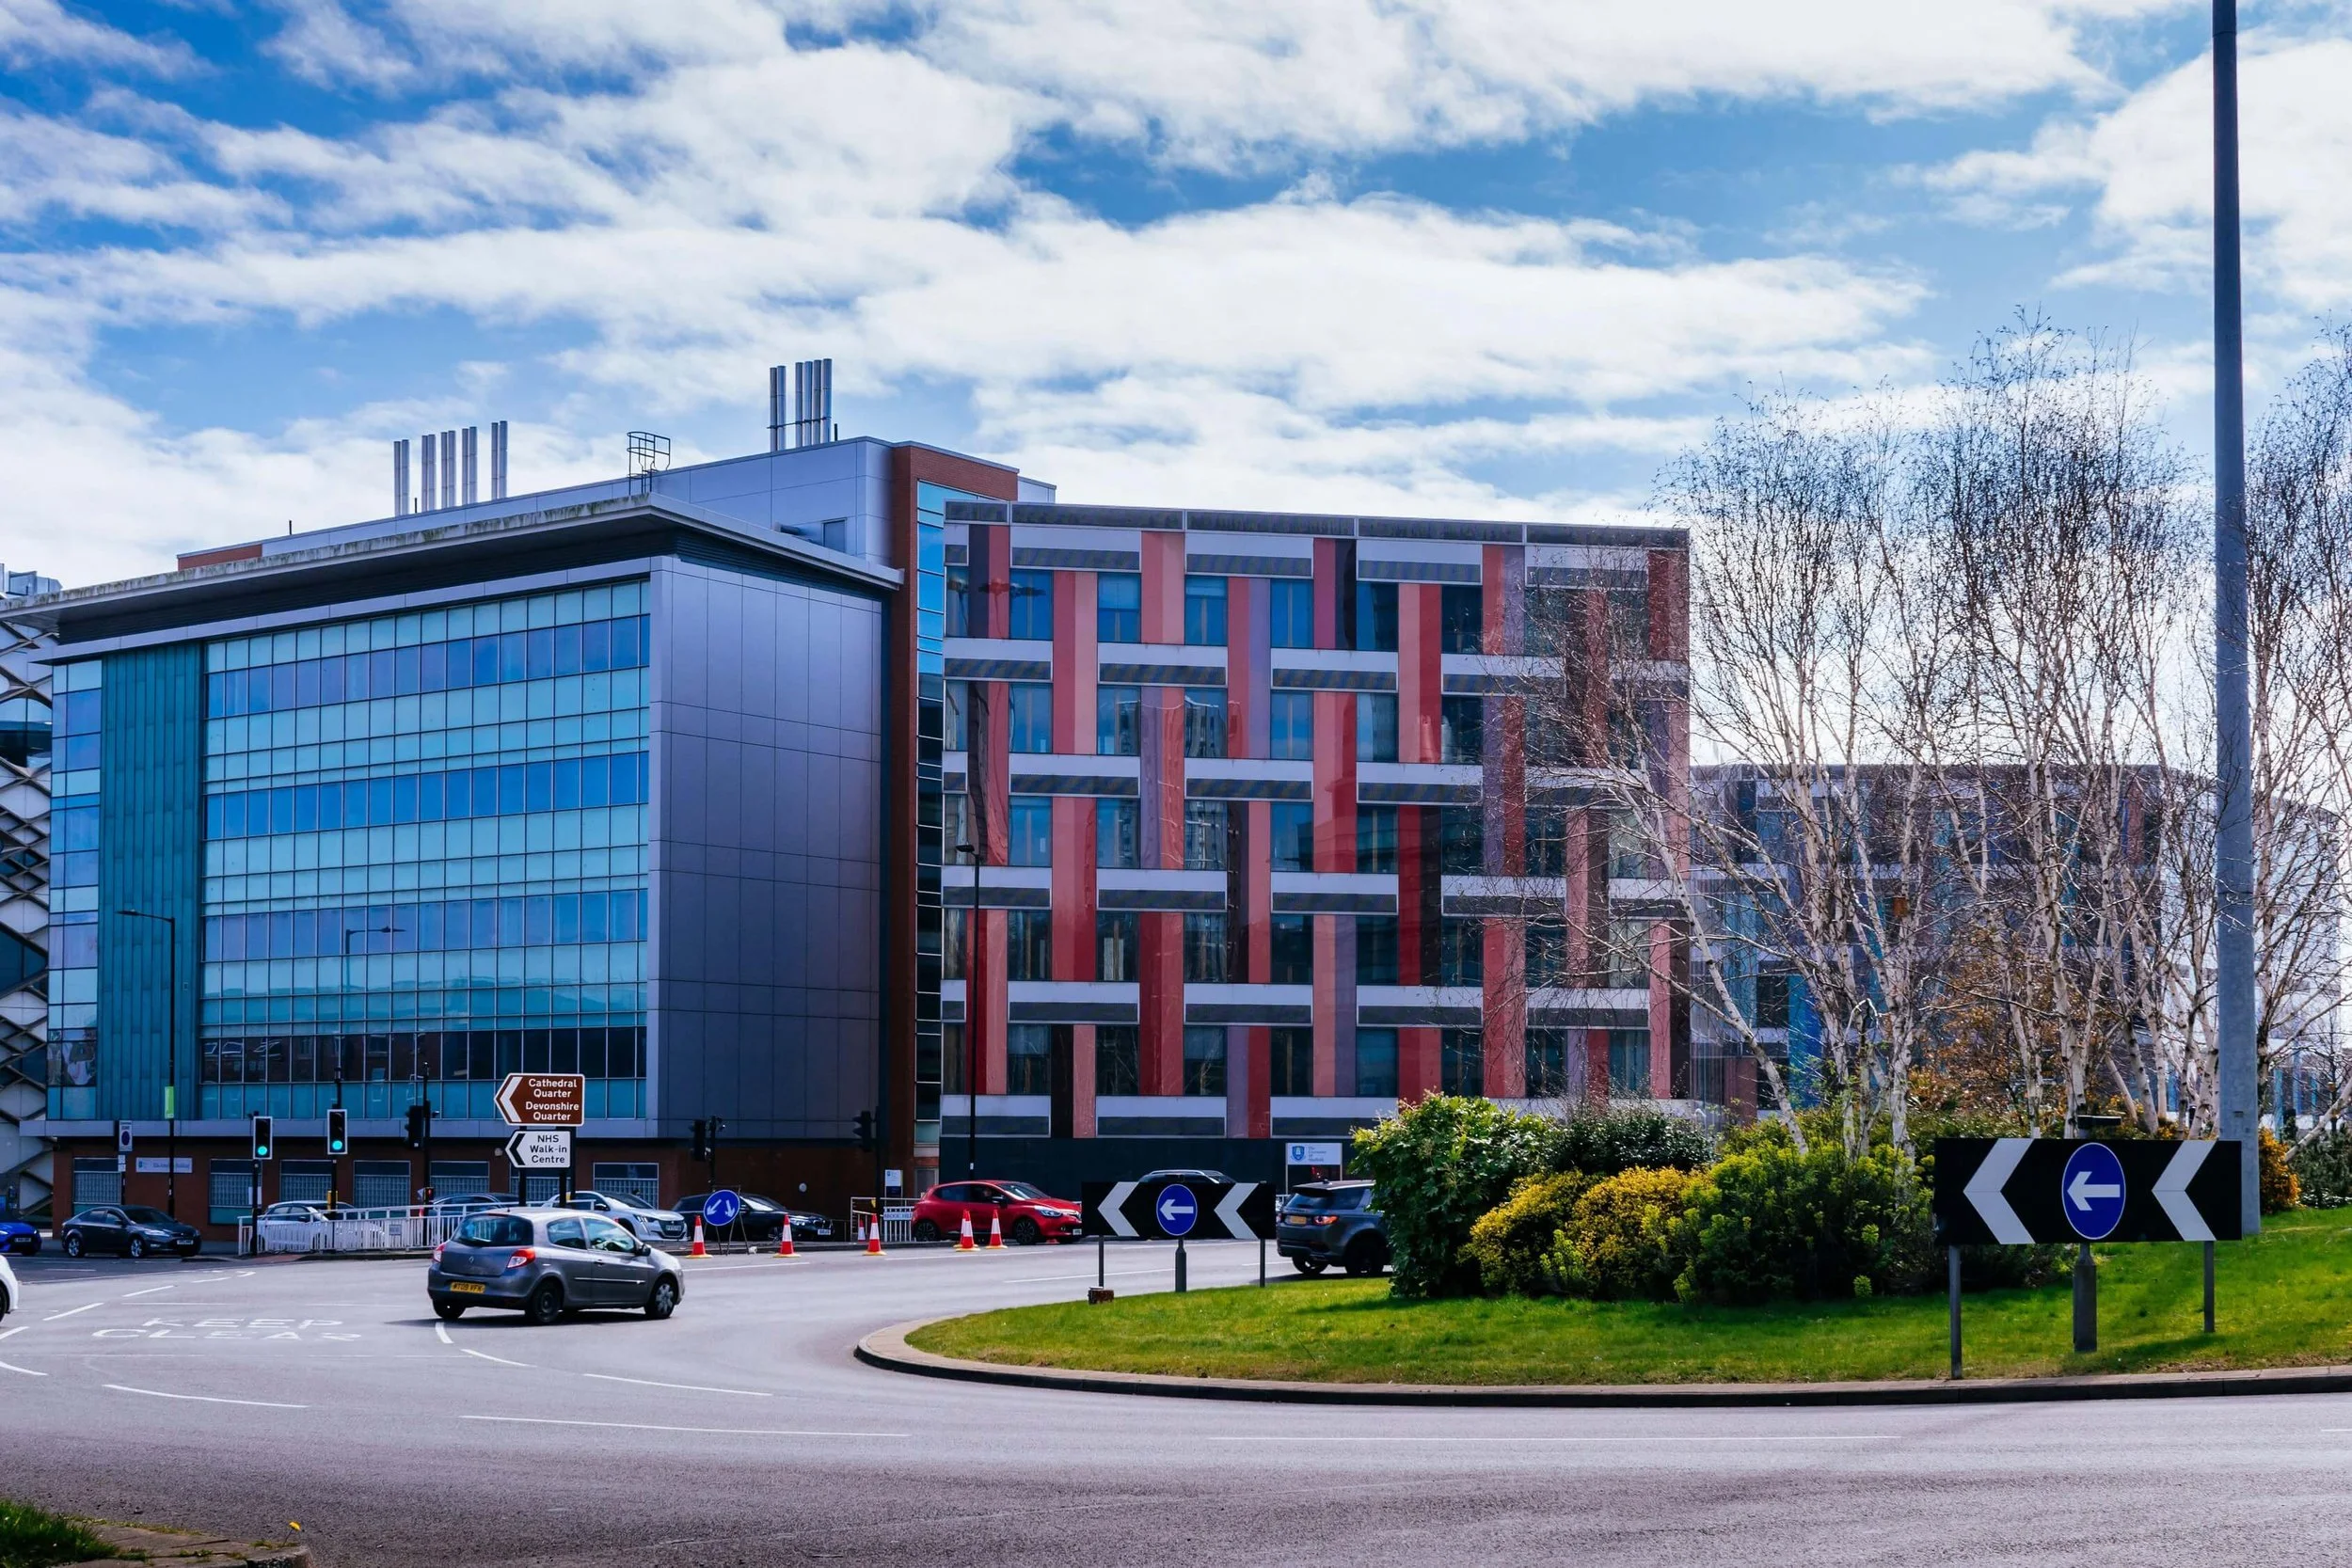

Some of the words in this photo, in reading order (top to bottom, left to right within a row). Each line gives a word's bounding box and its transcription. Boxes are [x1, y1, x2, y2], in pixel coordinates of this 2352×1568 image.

[528, 1078, 578, 1088] Cathedral
[533, 1088, 572, 1099] Quarter
[525, 1101, 580, 1111] Devonshire
[532, 1111, 571, 1121] Quarter
[537, 1134, 560, 1143] NHS
[529, 1144, 567, 1153] Walk-in
[531, 1154, 565, 1164] Centre
[142, 1318, 343, 1328] KEEP
[92, 1328, 361, 1341] CLEAR
